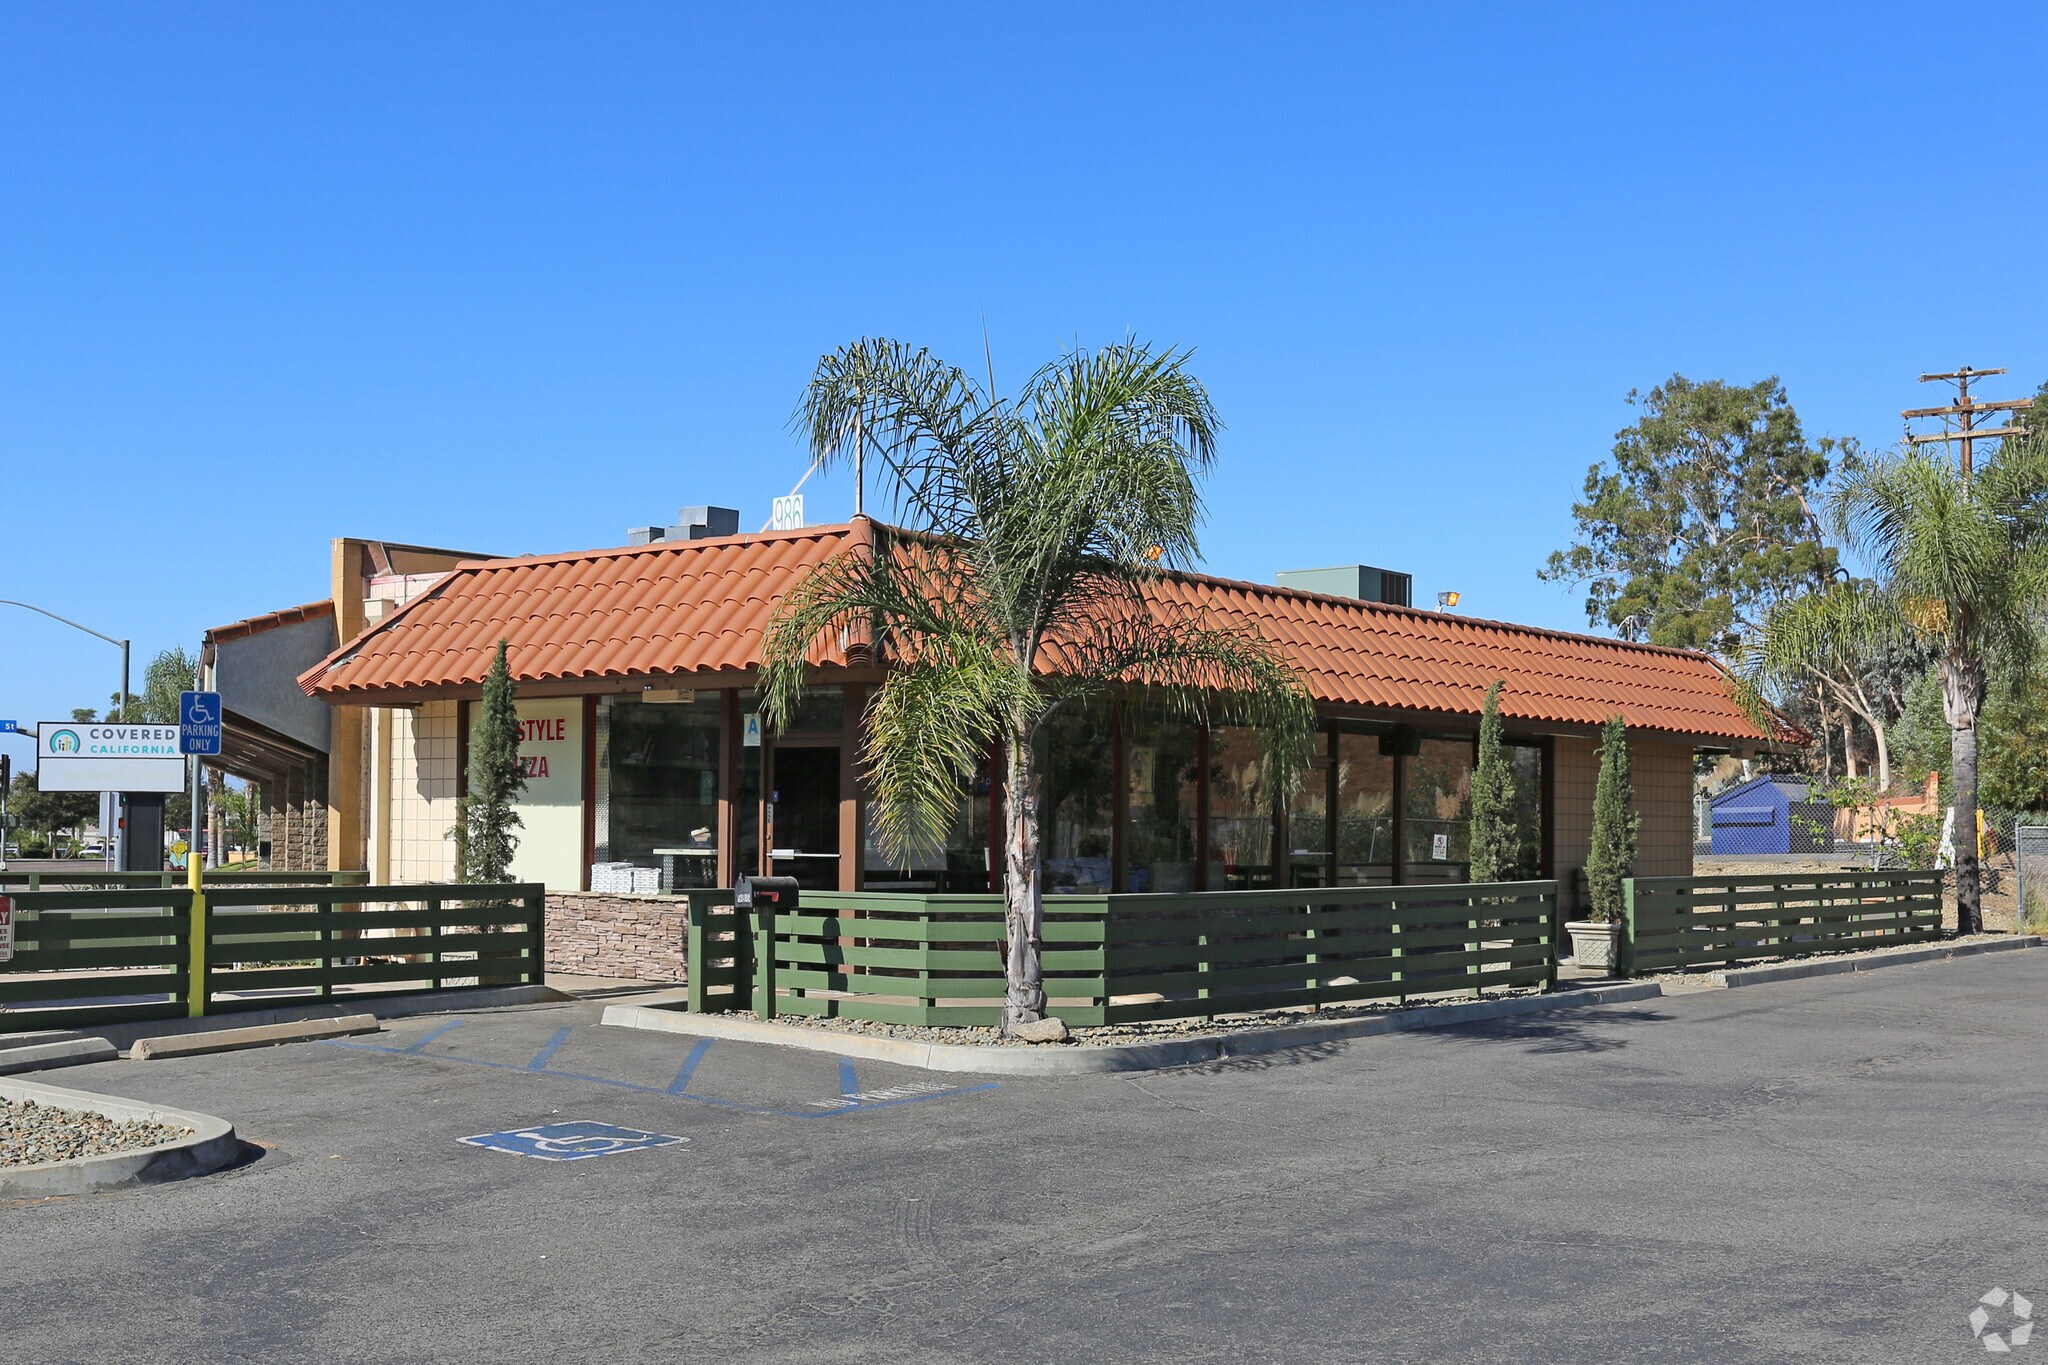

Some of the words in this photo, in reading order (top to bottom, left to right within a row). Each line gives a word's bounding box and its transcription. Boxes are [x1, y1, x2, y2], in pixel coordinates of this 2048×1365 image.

[774, 497, 802, 530] 986
[5, 722, 15, 730] St
[182, 724, 219, 737] PARKING
[748, 718, 759, 734] A
[89, 728, 176, 740] COVERED
[90, 745, 175, 754] CALIFORNIA
[189, 739, 211, 751] ONLY
